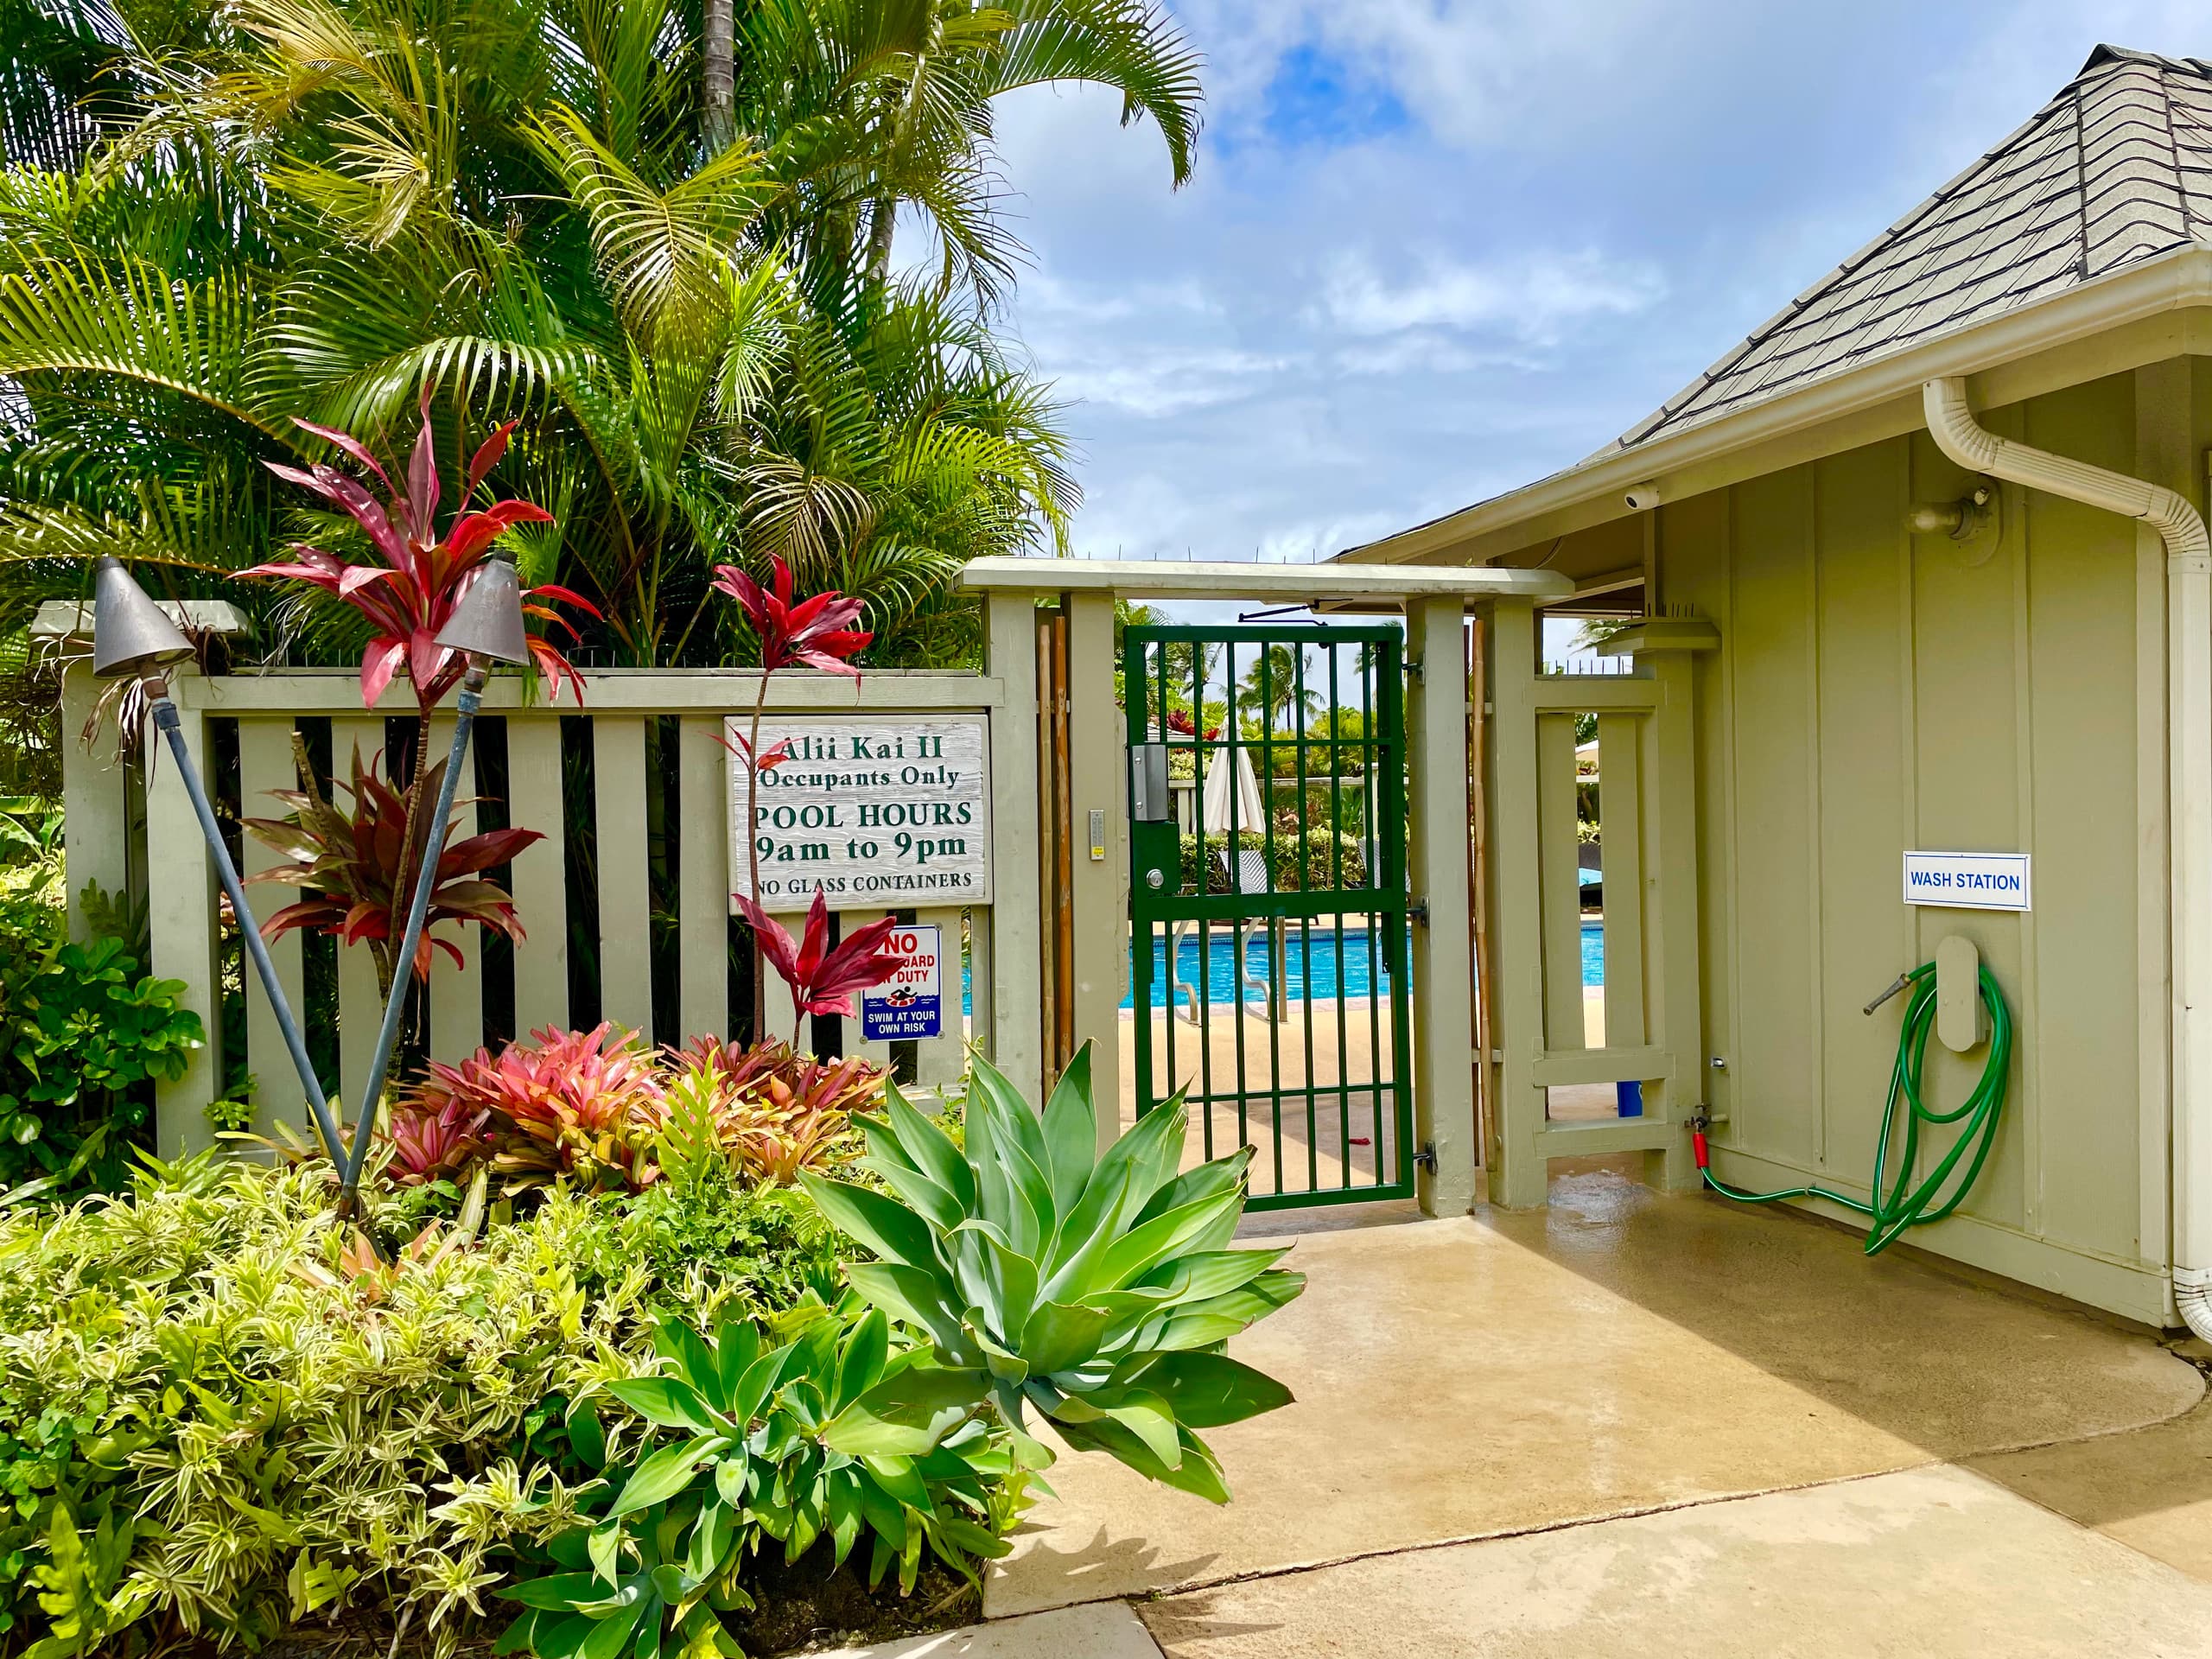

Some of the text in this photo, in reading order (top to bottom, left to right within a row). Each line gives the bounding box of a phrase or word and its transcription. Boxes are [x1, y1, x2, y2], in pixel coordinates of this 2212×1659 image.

[779, 735, 943, 760] Alii Kai II
[760, 765, 959, 791] Occupants Only
[755, 802, 972, 830] POOL HOURS
[756, 831, 967, 864] 9am to 9pm
[788, 877, 846, 894] GLASS
[853, 872, 972, 891] CONTAINERS
[1910, 871, 2020, 891] WASH STATION
[884, 933, 918, 955] NO
[897, 969, 929, 983] DUTY
[868, 1010, 936, 1023] SWIM AT YOUR
[879, 1022, 925, 1034] OWN RISK
